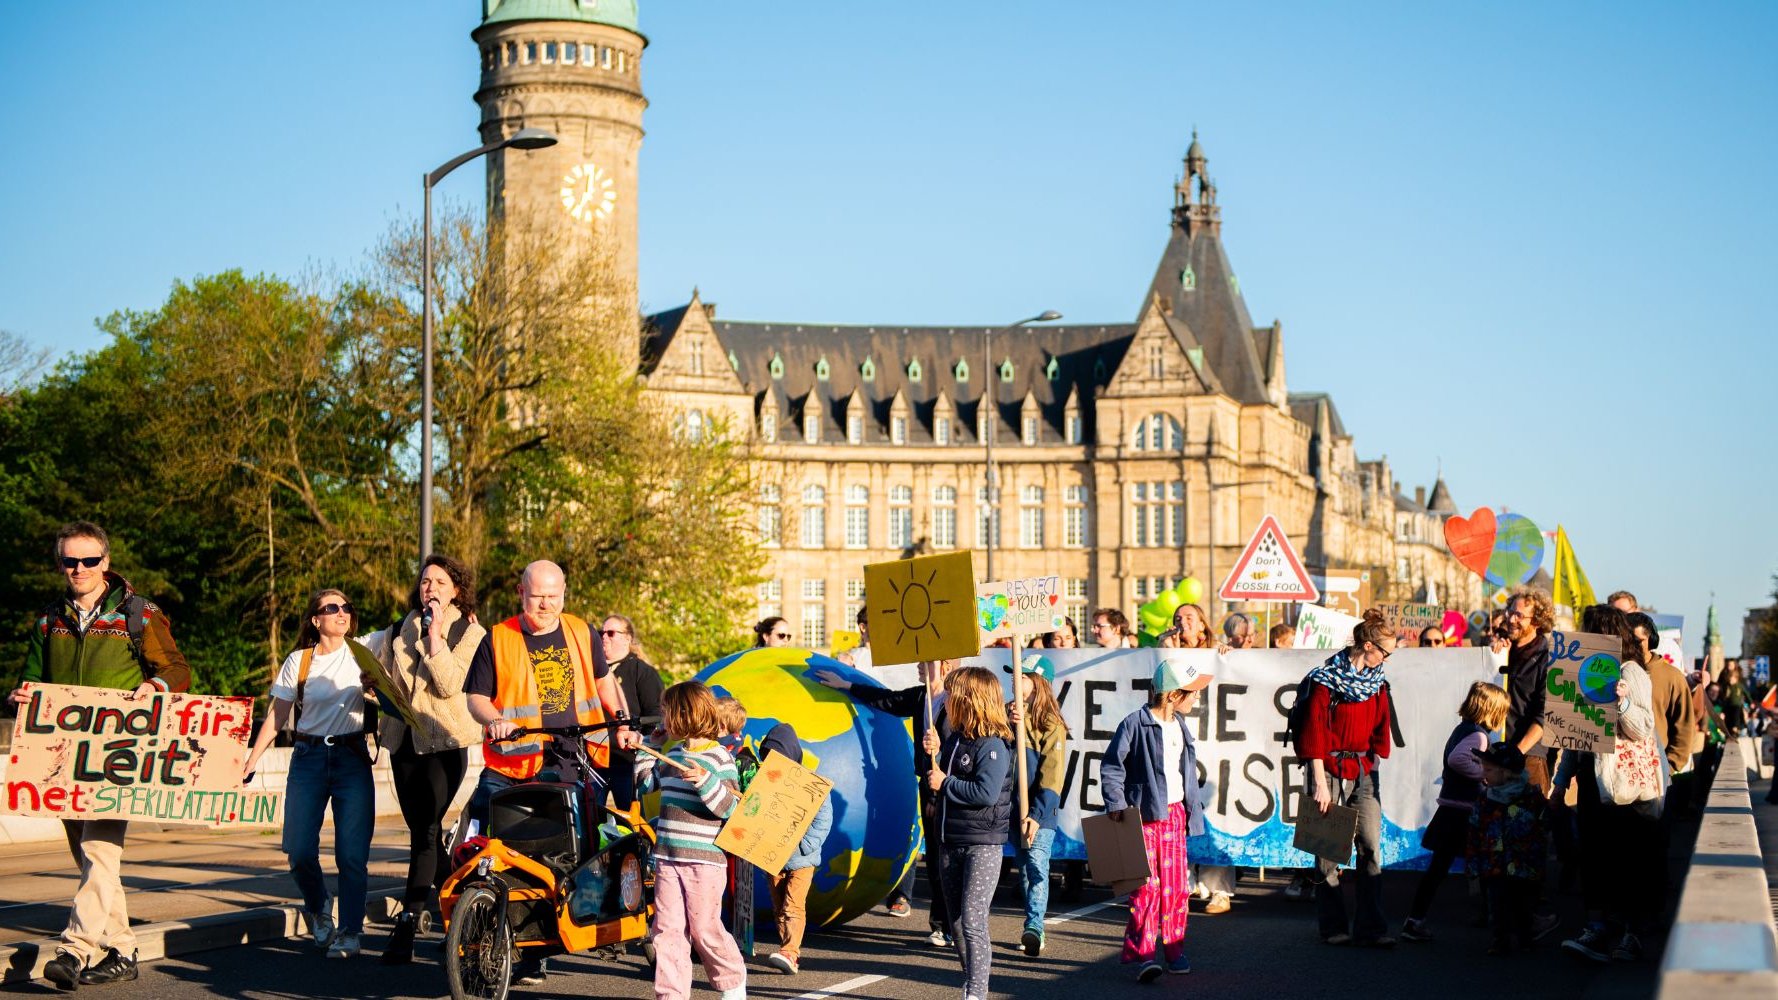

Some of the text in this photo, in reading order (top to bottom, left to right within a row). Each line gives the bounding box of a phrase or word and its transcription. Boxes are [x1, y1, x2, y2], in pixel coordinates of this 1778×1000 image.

[1255, 556, 1282, 565] Don't
[1006, 577, 1059, 597] RESPECT
[1235, 582, 1303, 592] FOSSIL FOOL
[1016, 593, 1047, 611] YOUR
[1006, 609, 1054, 626] MOTHER
[1377, 604, 1445, 619] THE CLIMATE
[1546, 630, 1584, 667] Be
[1590, 656, 1611, 674] the
[1546, 667, 1615, 737] CHANGE
[25, 690, 235, 737] Land fir
[1545, 710, 1600, 743] TAKE CLIMATE
[1552, 735, 1593, 751] ACTION
[7, 780, 87, 813] net
